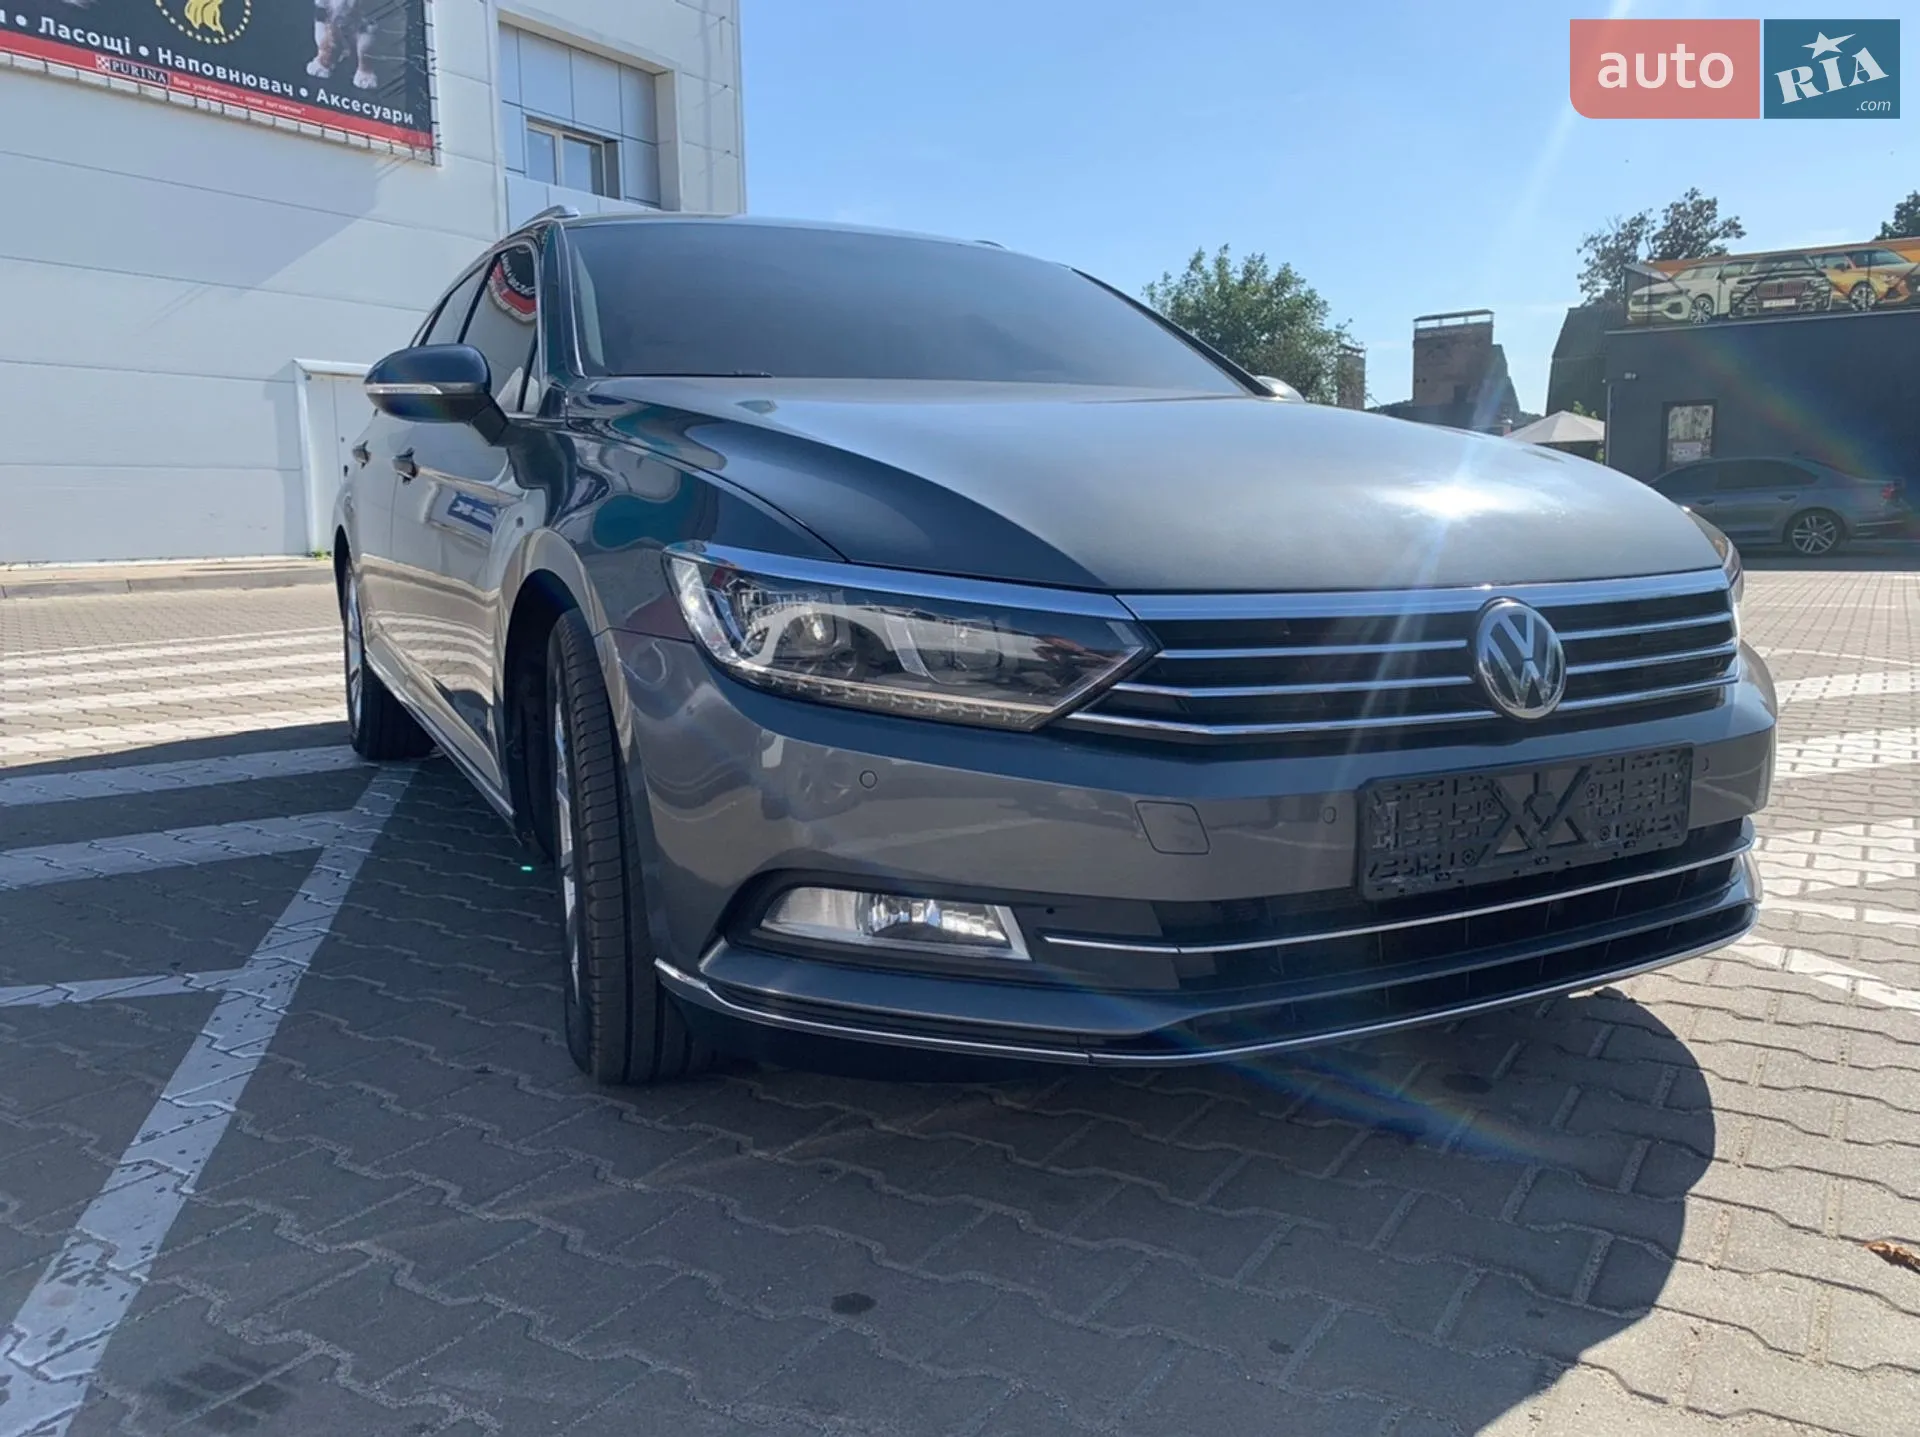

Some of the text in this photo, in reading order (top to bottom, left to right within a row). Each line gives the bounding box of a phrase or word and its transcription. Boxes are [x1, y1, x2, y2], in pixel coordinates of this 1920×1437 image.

[38, 15, 131, 55] Ласощі
[158, 47, 293, 97] Наповнювач
[317, 88, 414, 125] Аксесуари
[111, 60, 167, 84] PURINA
